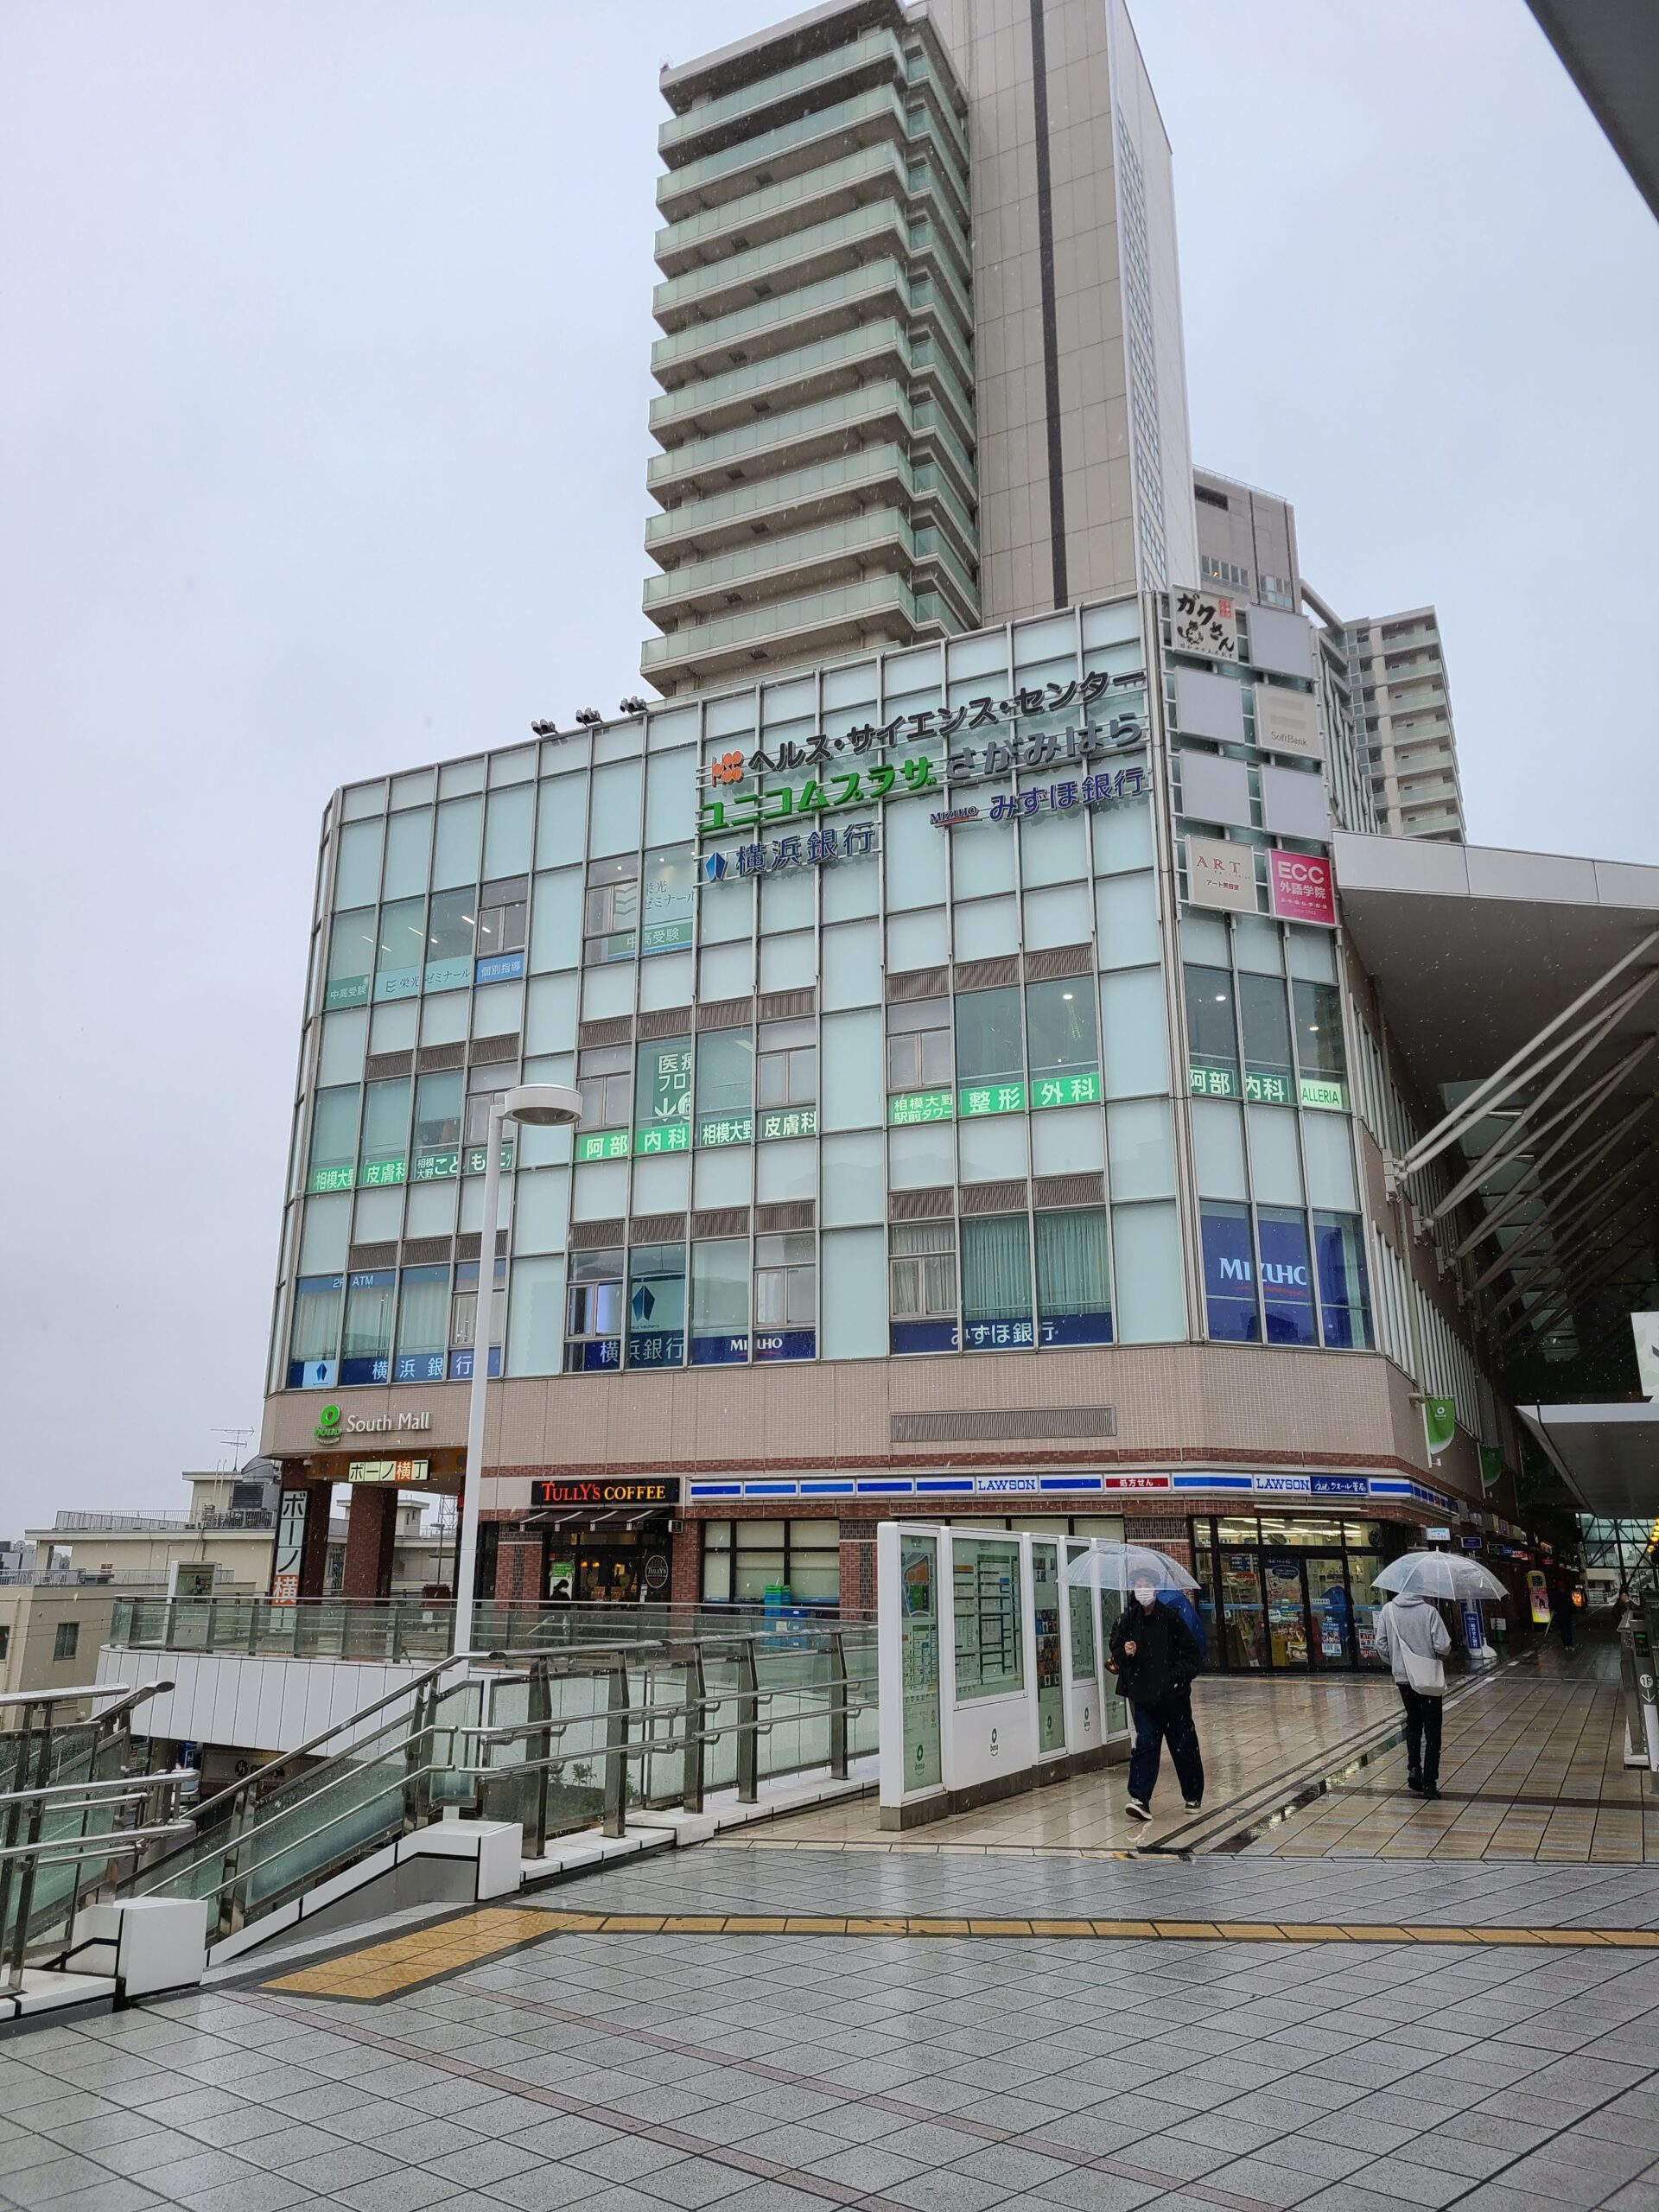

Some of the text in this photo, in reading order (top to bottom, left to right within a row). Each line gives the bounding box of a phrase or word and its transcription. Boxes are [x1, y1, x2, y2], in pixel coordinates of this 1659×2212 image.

[748, 670, 1146, 772] ヘルス・サイエンス・センター
[1271, 732, 1307, 746] SoftBank
[700, 713, 1141, 831] ユニコムプラザ さがみはら
[930, 766, 1145, 824] MIZUHO みずほ銀行
[735, 821, 874, 877] 横浜銀行
[1197, 855, 1241, 874] ART
[1278, 861, 1325, 884] ECC
[1280, 881, 1326, 899] 外語学院
[480, 960, 521, 977] 個別指導
[330, 983, 366, 1001] 中高受験
[969, 1077, 1095, 1113] 整形 外科
[1190, 1069, 1286, 1103] 阿部 内科
[893, 1092, 953, 1113] 相模大野
[765, 1111, 817, 1138] 皮膚科
[587, 1127, 687, 1159] 阿部 内科
[417, 1156, 435, 1168] 相模
[416, 1168, 434, 1179] 大野
[352, 1275, 374, 1287] ATM
[730, 1338, 783, 1351] MIUHO
[372, 1355, 474, 1381] 横浜銀行
[346, 1411, 430, 1432] South Mall
[350, 1461, 428, 1480] ボーノ横丁
[604, 1485, 666, 1500] COFFEE
[977, 1479, 1036, 1491] LAWSON
[1119, 1478, 1154, 1488] 処方せん
[1256, 1478, 1310, 1491] LAWSON
